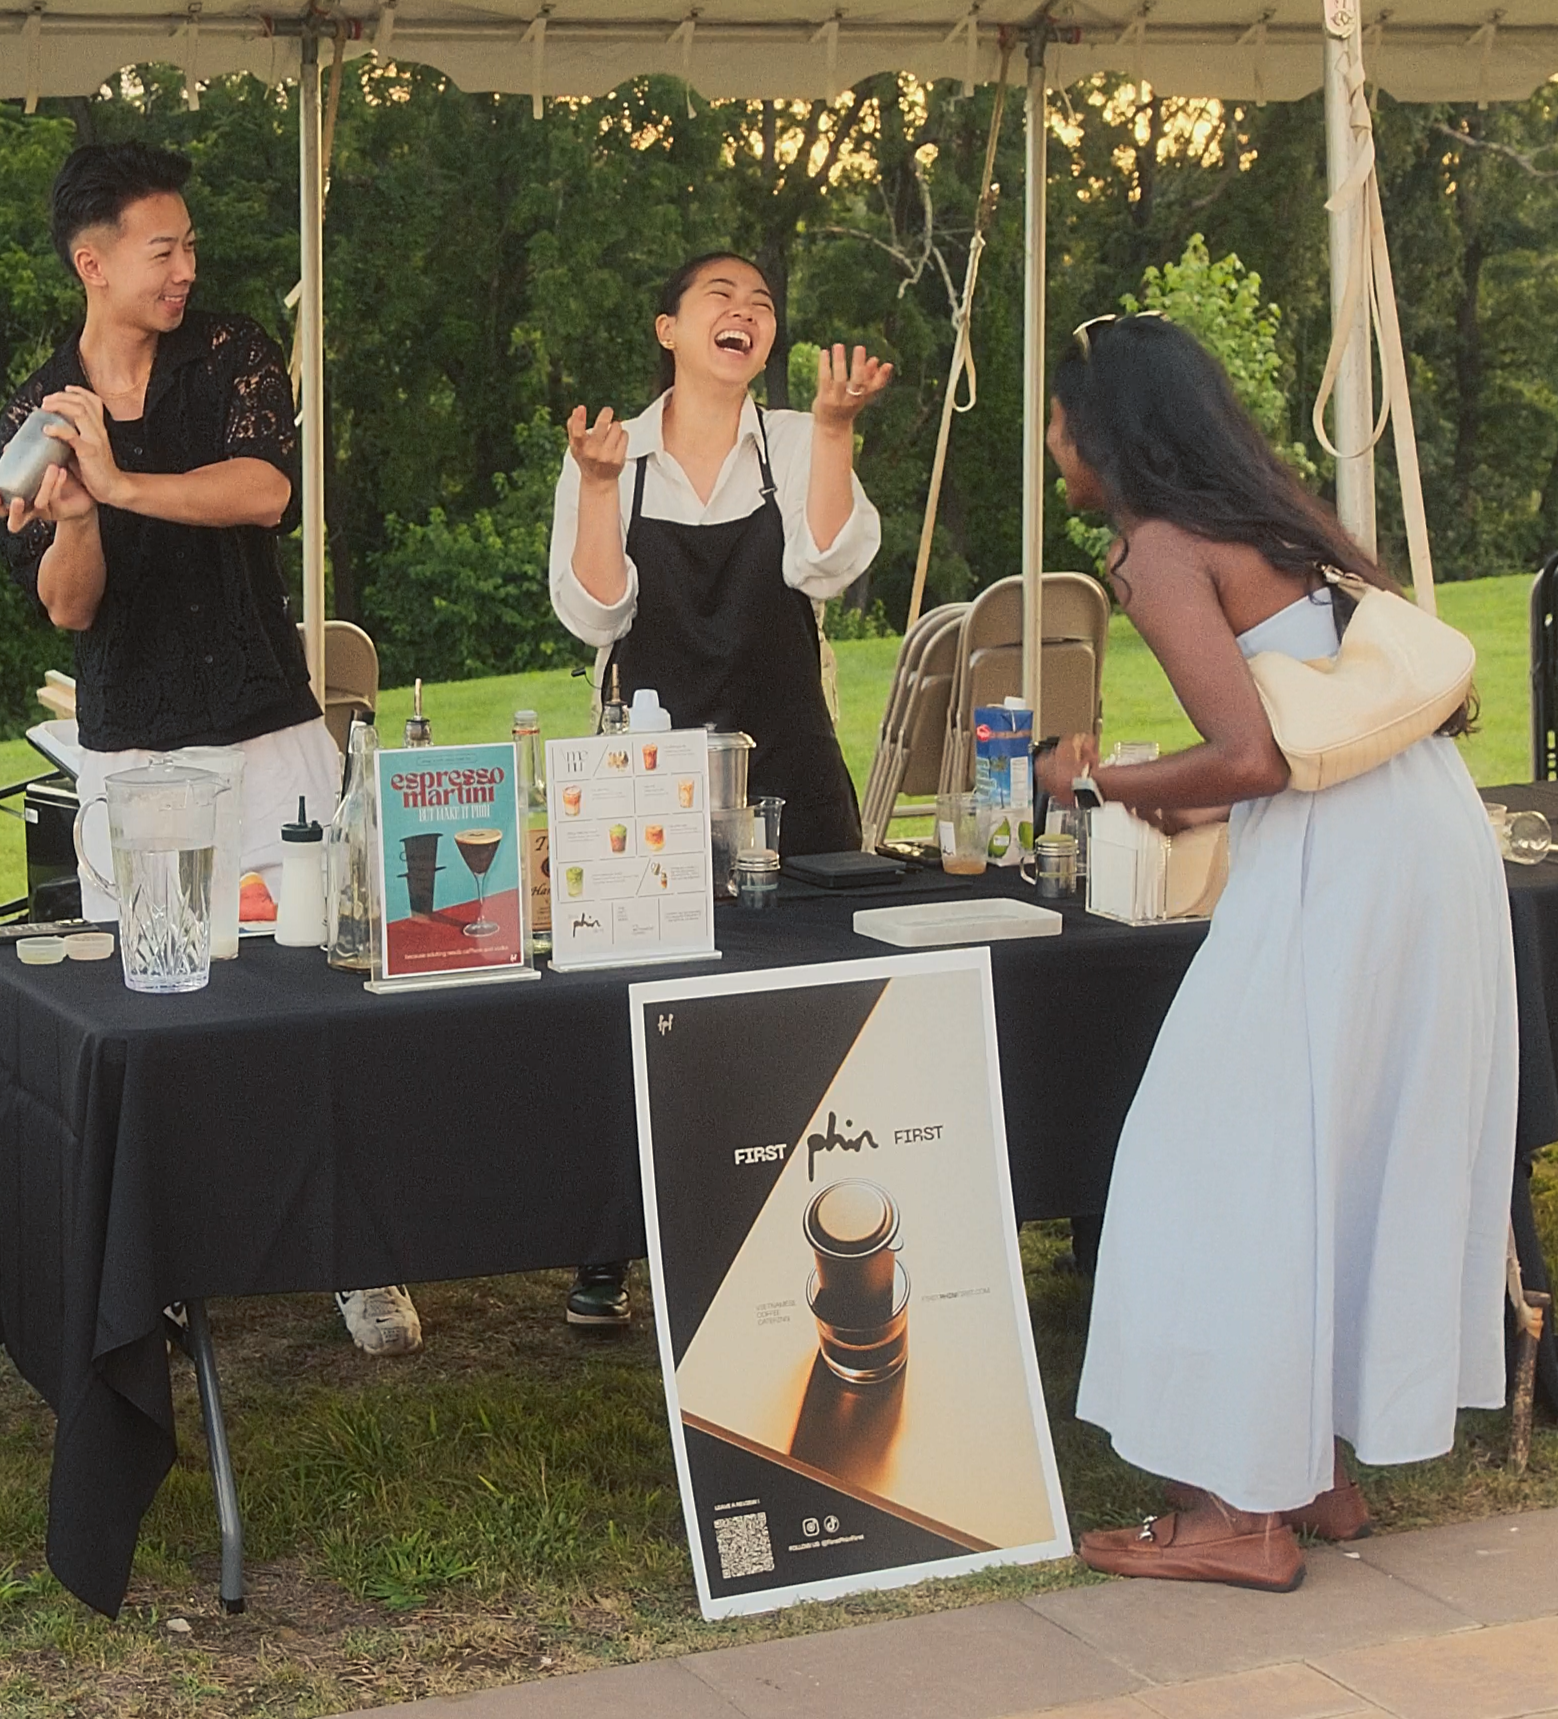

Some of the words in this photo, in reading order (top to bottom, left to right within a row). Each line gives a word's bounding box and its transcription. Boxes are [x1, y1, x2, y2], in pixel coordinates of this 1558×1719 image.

[390, 766, 505, 799] espresso
[403, 785, 495, 808] martini
[419, 807, 433, 822] BUT
[436, 806, 459, 821] MAKE
[462, 805, 469, 820] IT
[573, 912, 601, 938] phin
[734, 1144, 787, 1165] FIRST
[807, 1111, 879, 1182] phin
[894, 1125, 943, 1144] FIRST
